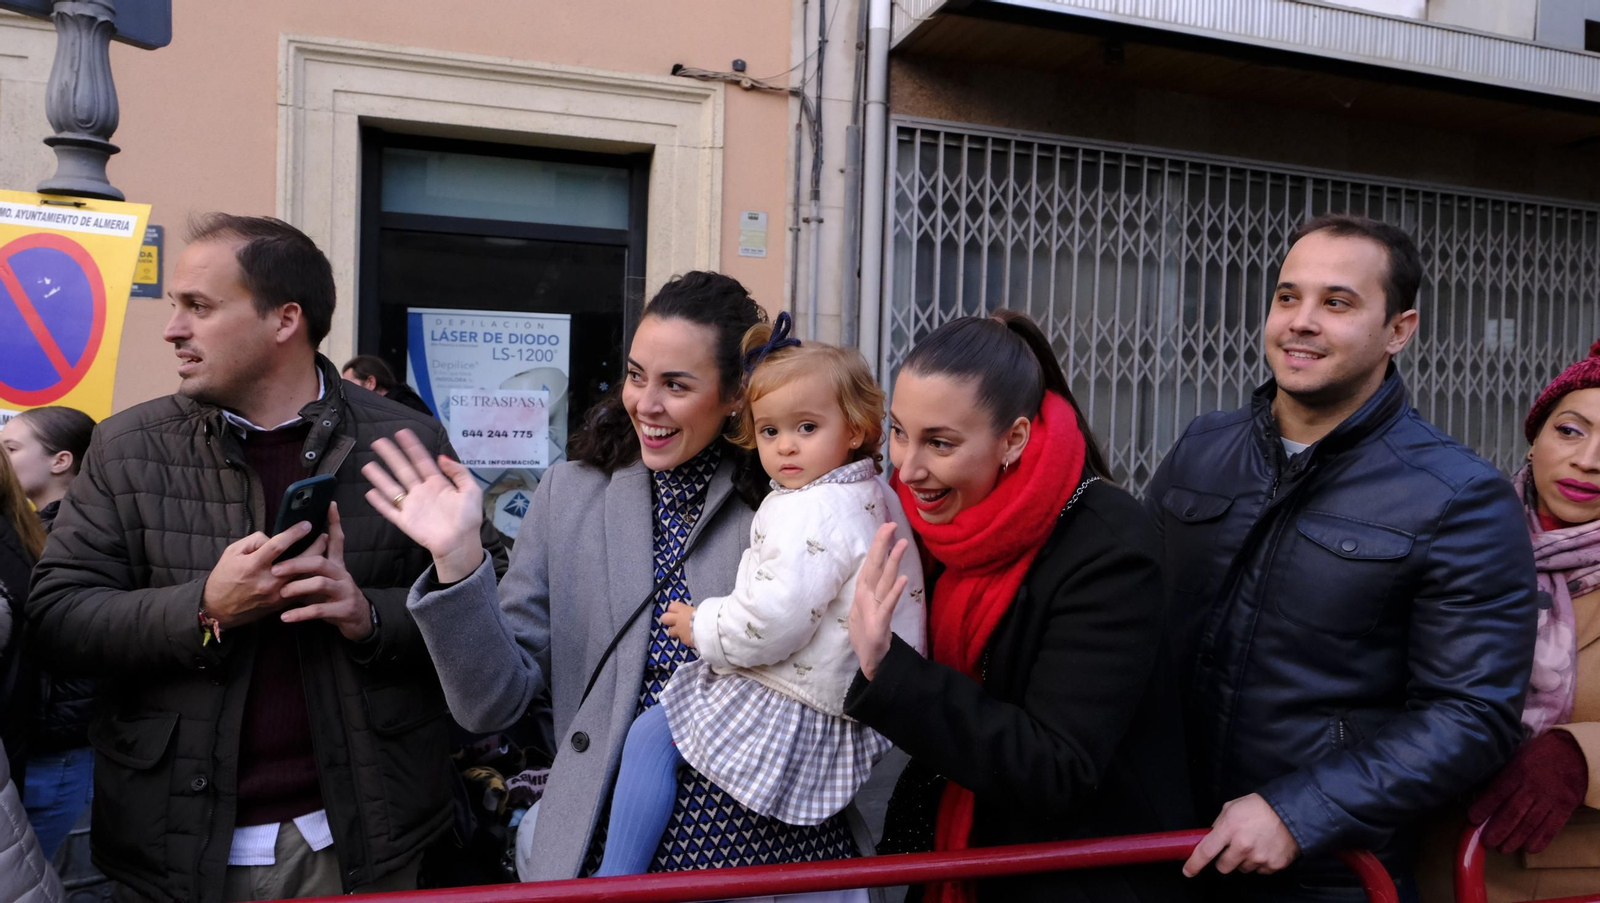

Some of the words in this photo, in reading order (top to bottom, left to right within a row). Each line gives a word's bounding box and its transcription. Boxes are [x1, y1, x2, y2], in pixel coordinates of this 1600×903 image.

[15, 209, 79, 225] AYUNTAMIENTO
[80, 216, 92, 227] DE
[93, 218, 130, 231] ALMERIA
[435, 318, 545, 330] DEPILACIÓN
[431, 328, 478, 343] LÁSER
[483, 332, 503, 344] DE
[509, 333, 560, 346] DIODO
[451, 395, 470, 407] SE
[472, 395, 545, 408] TRASPASA
[462, 429, 483, 438] 644
[487, 429, 509, 438] 244
[512, 430, 533, 438] 775
